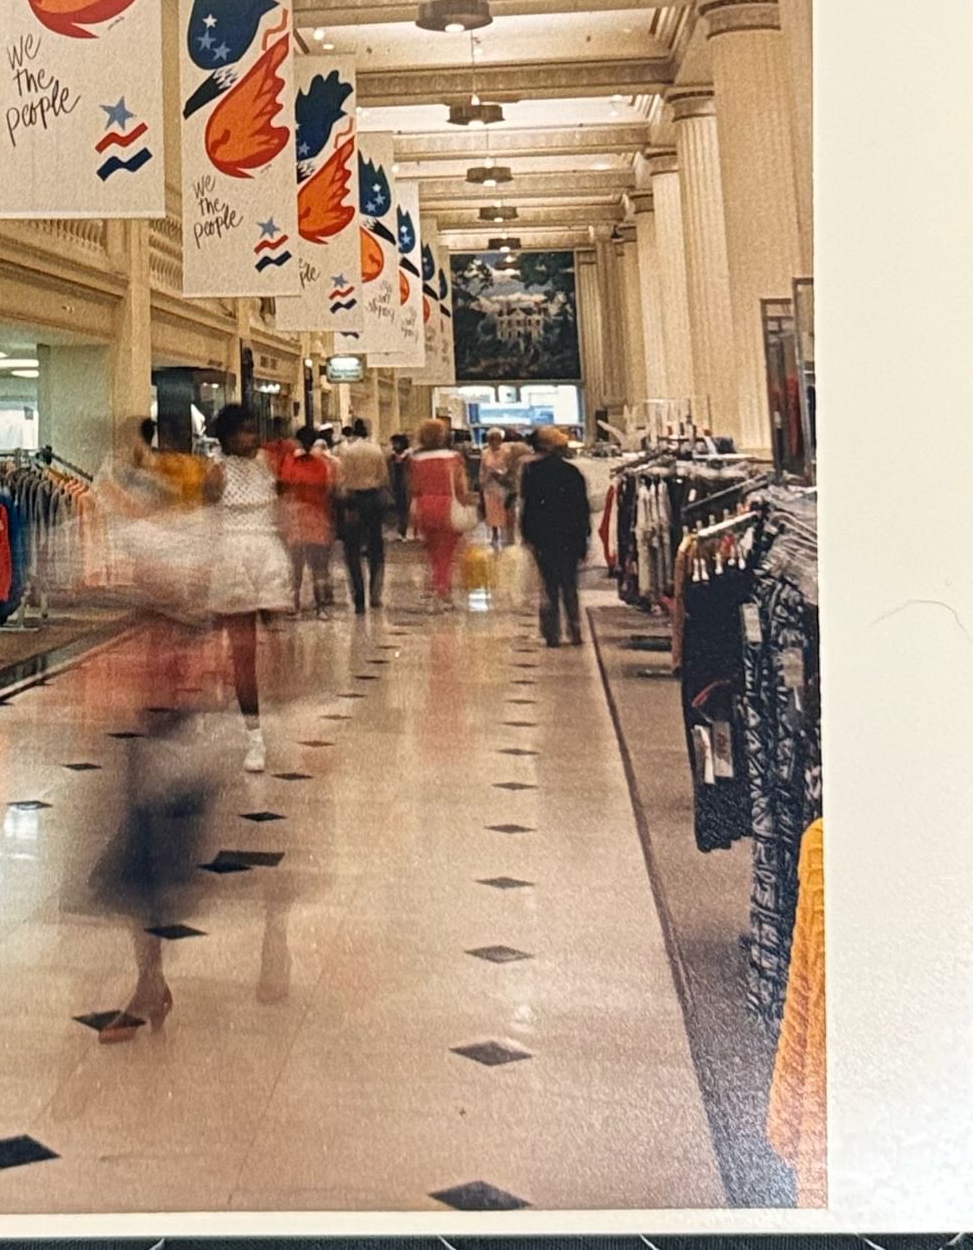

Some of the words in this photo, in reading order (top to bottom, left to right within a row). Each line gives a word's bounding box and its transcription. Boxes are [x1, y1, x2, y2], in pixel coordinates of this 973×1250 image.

[13, 68, 55, 97] the
[5, 79, 82, 148] people
[198, 197, 226, 217] the
[193, 204, 244, 250] people
